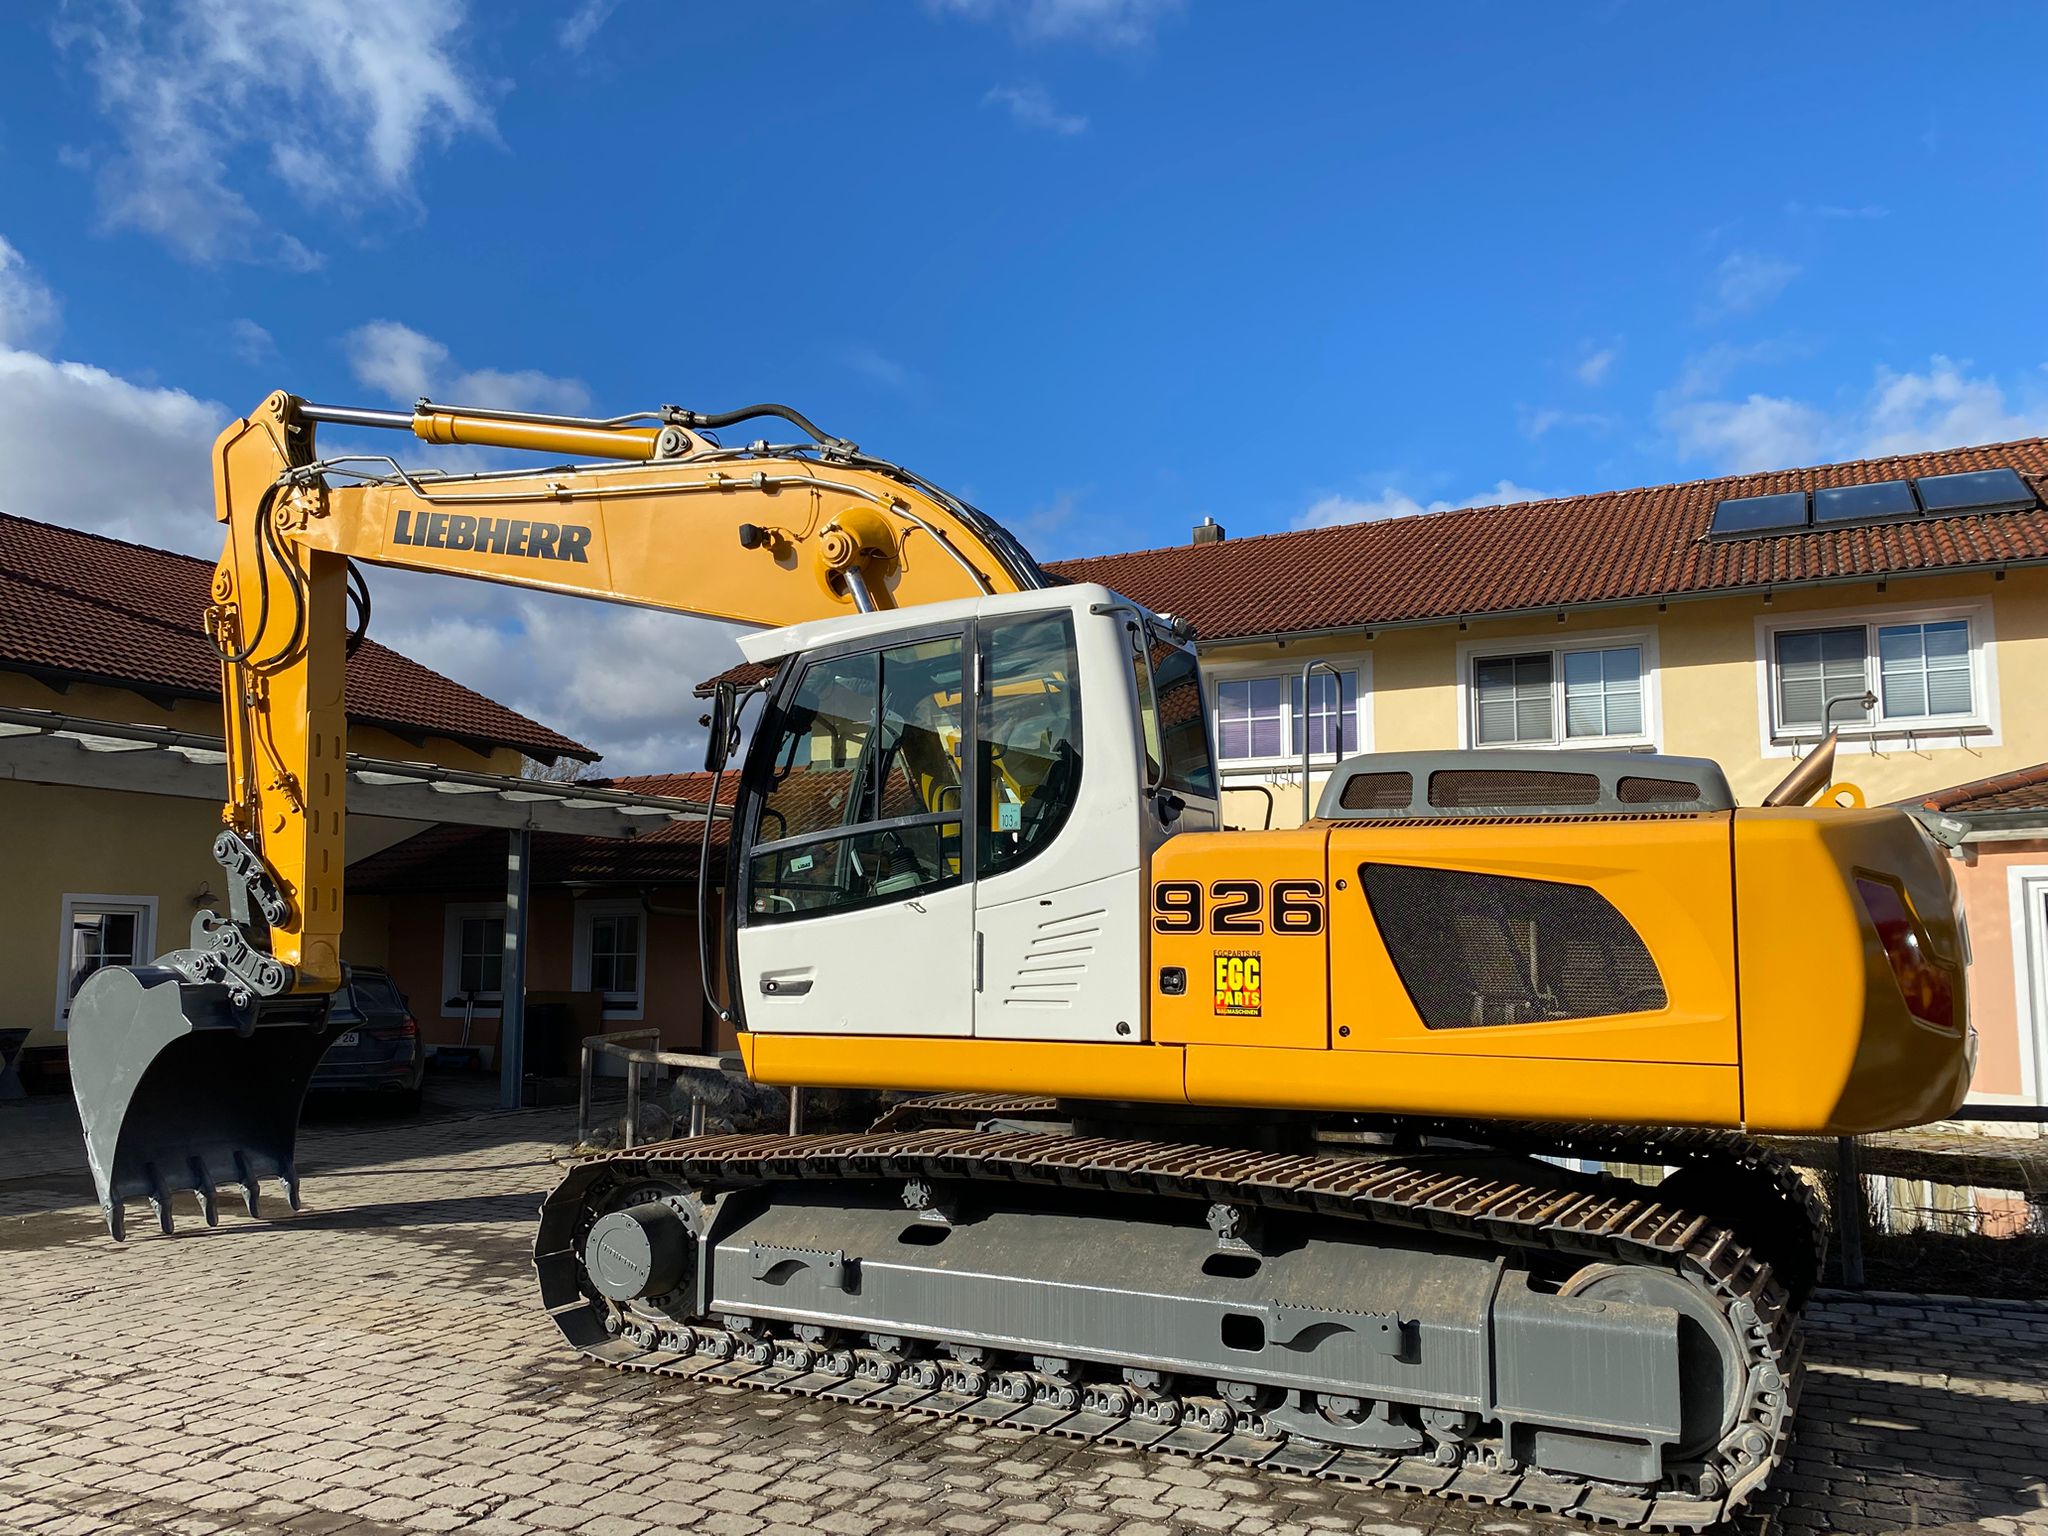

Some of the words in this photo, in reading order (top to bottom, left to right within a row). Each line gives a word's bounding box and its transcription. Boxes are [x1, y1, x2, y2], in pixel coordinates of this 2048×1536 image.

[393, 509, 592, 563] LIEBHERR
[1002, 814, 1013, 827] 103
[1153, 879, 1325, 935] 926
[1216, 957, 1260, 990] EGC
[1216, 991, 1260, 1006] PARTS
[343, 1034, 355, 1043] 26
